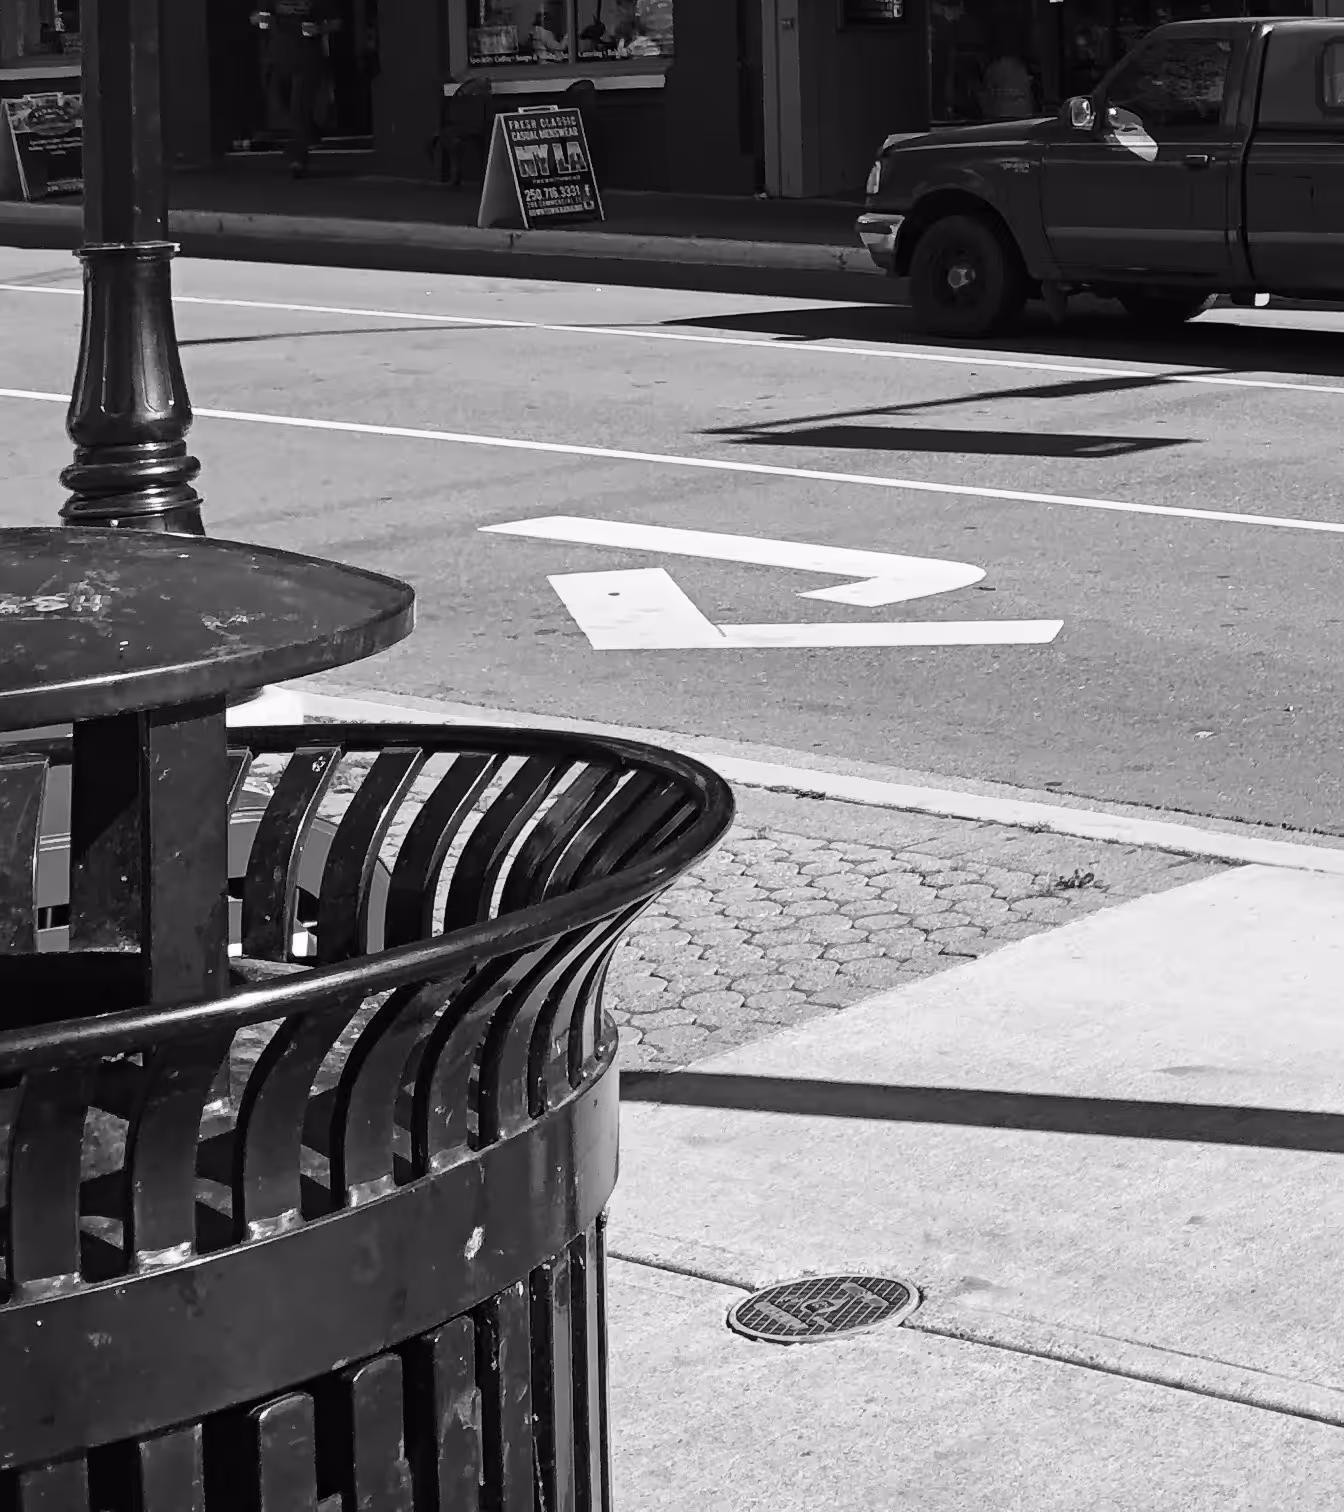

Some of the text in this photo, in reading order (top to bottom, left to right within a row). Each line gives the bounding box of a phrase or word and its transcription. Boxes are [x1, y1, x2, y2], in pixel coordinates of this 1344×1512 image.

[509, 116, 577, 130] FRESH CLASSIC
[523, 184, 581, 201] 250.716.3331
